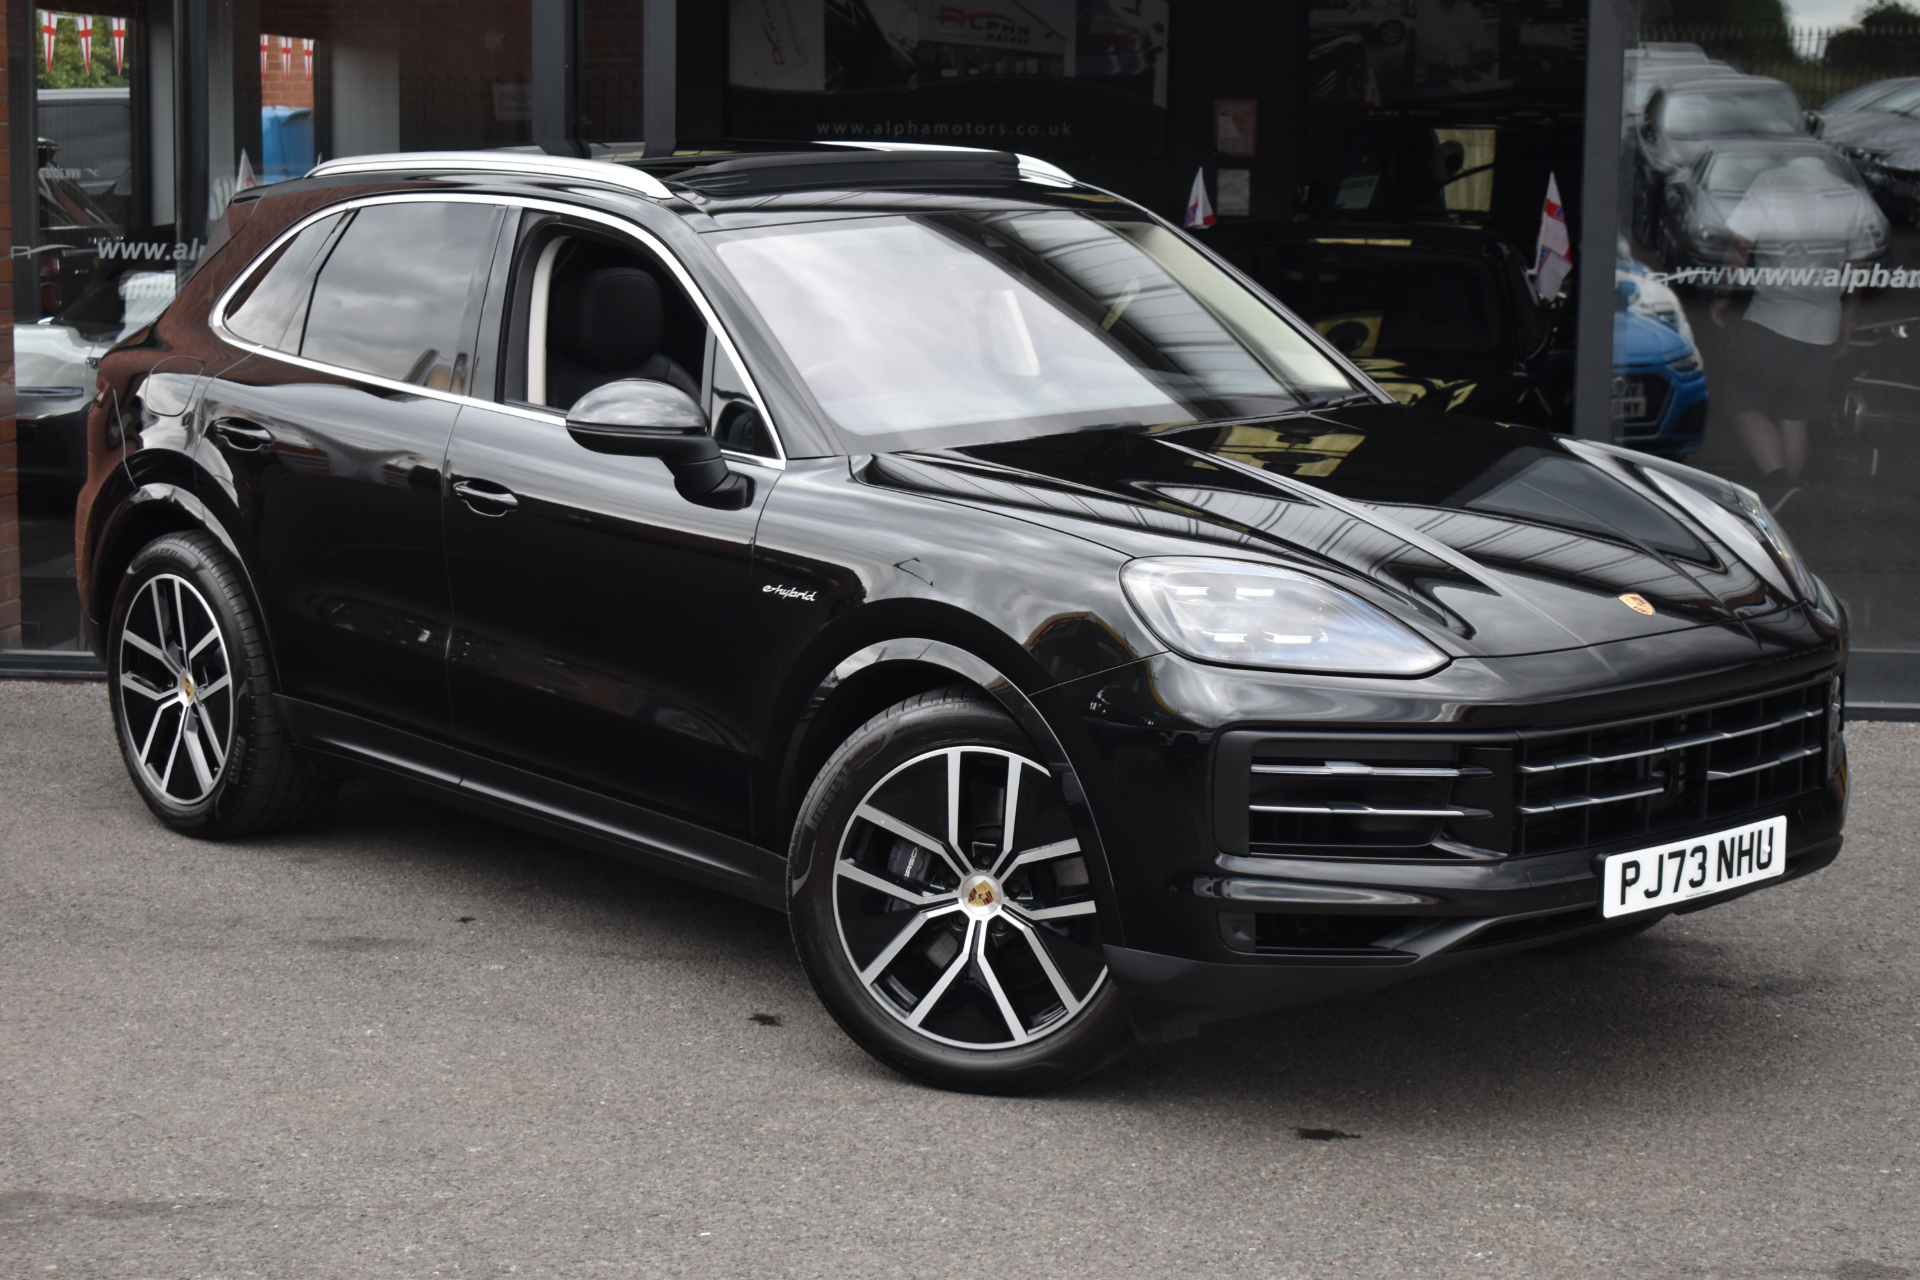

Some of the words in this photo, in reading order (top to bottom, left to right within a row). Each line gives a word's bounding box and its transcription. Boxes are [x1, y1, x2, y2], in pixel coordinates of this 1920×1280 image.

[816, 120, 1072, 138] www.alphamotors.co.uk
[762, 584, 818, 602] e-hybrid
[804, 764, 851, 832] PIRELLI
[1620, 844, 1708, 905] PJ73
[1716, 826, 1774, 883] NHU
